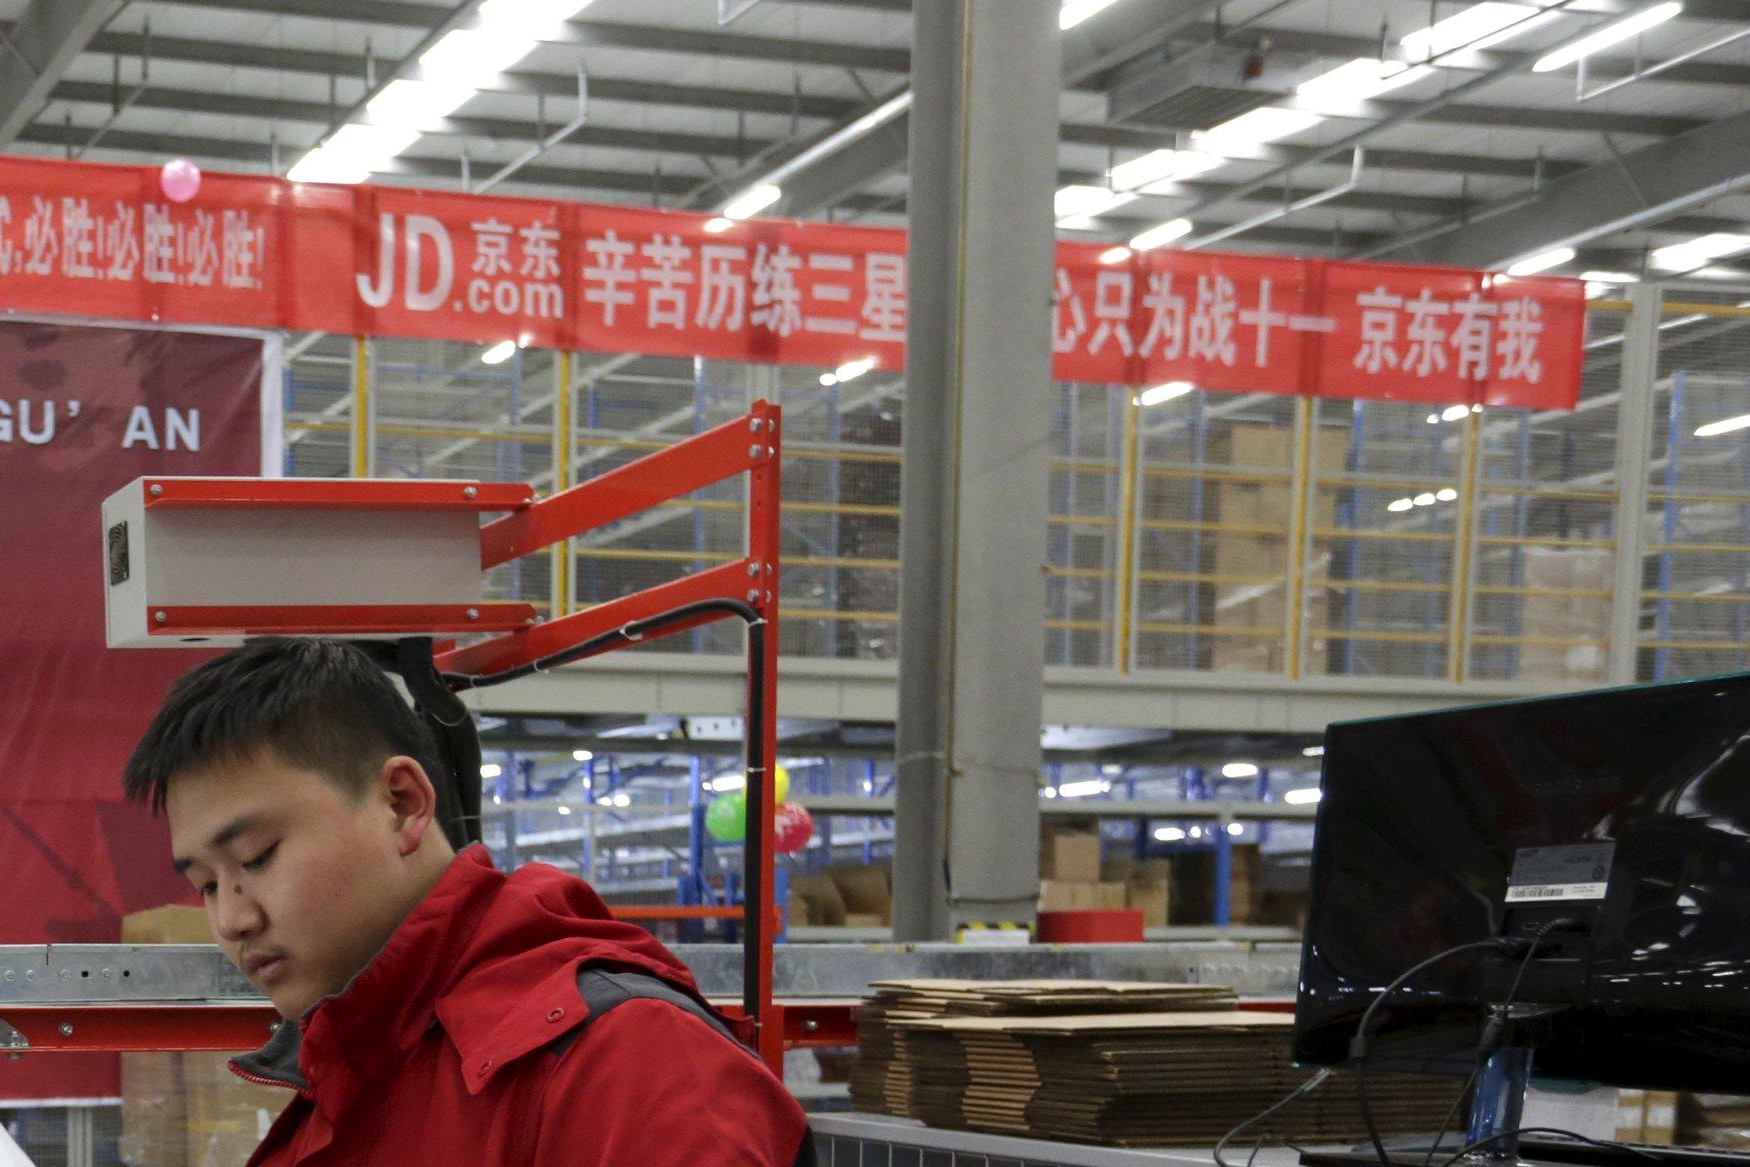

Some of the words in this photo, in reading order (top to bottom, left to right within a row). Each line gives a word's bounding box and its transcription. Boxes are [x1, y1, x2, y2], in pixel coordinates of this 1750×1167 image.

[470, 218, 560, 278] 京东
[1354, 286, 1543, 383] 京东有我
